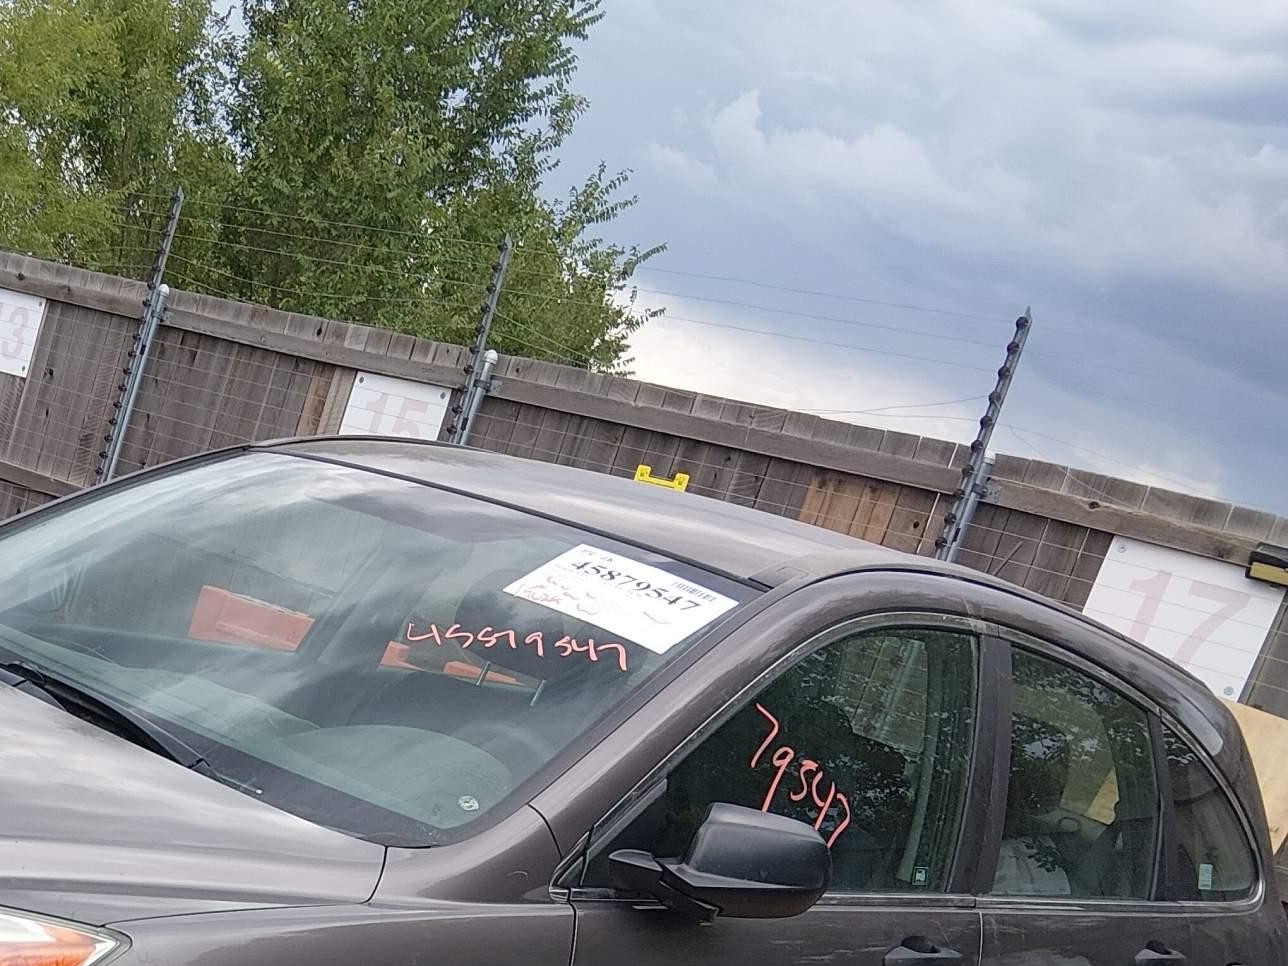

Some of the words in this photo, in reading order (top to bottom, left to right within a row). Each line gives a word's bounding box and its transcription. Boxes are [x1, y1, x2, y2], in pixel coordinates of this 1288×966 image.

[571, 560, 702, 612] 45879547
[1128, 569, 1252, 667] 17
[749, 702, 852, 849] 79547
